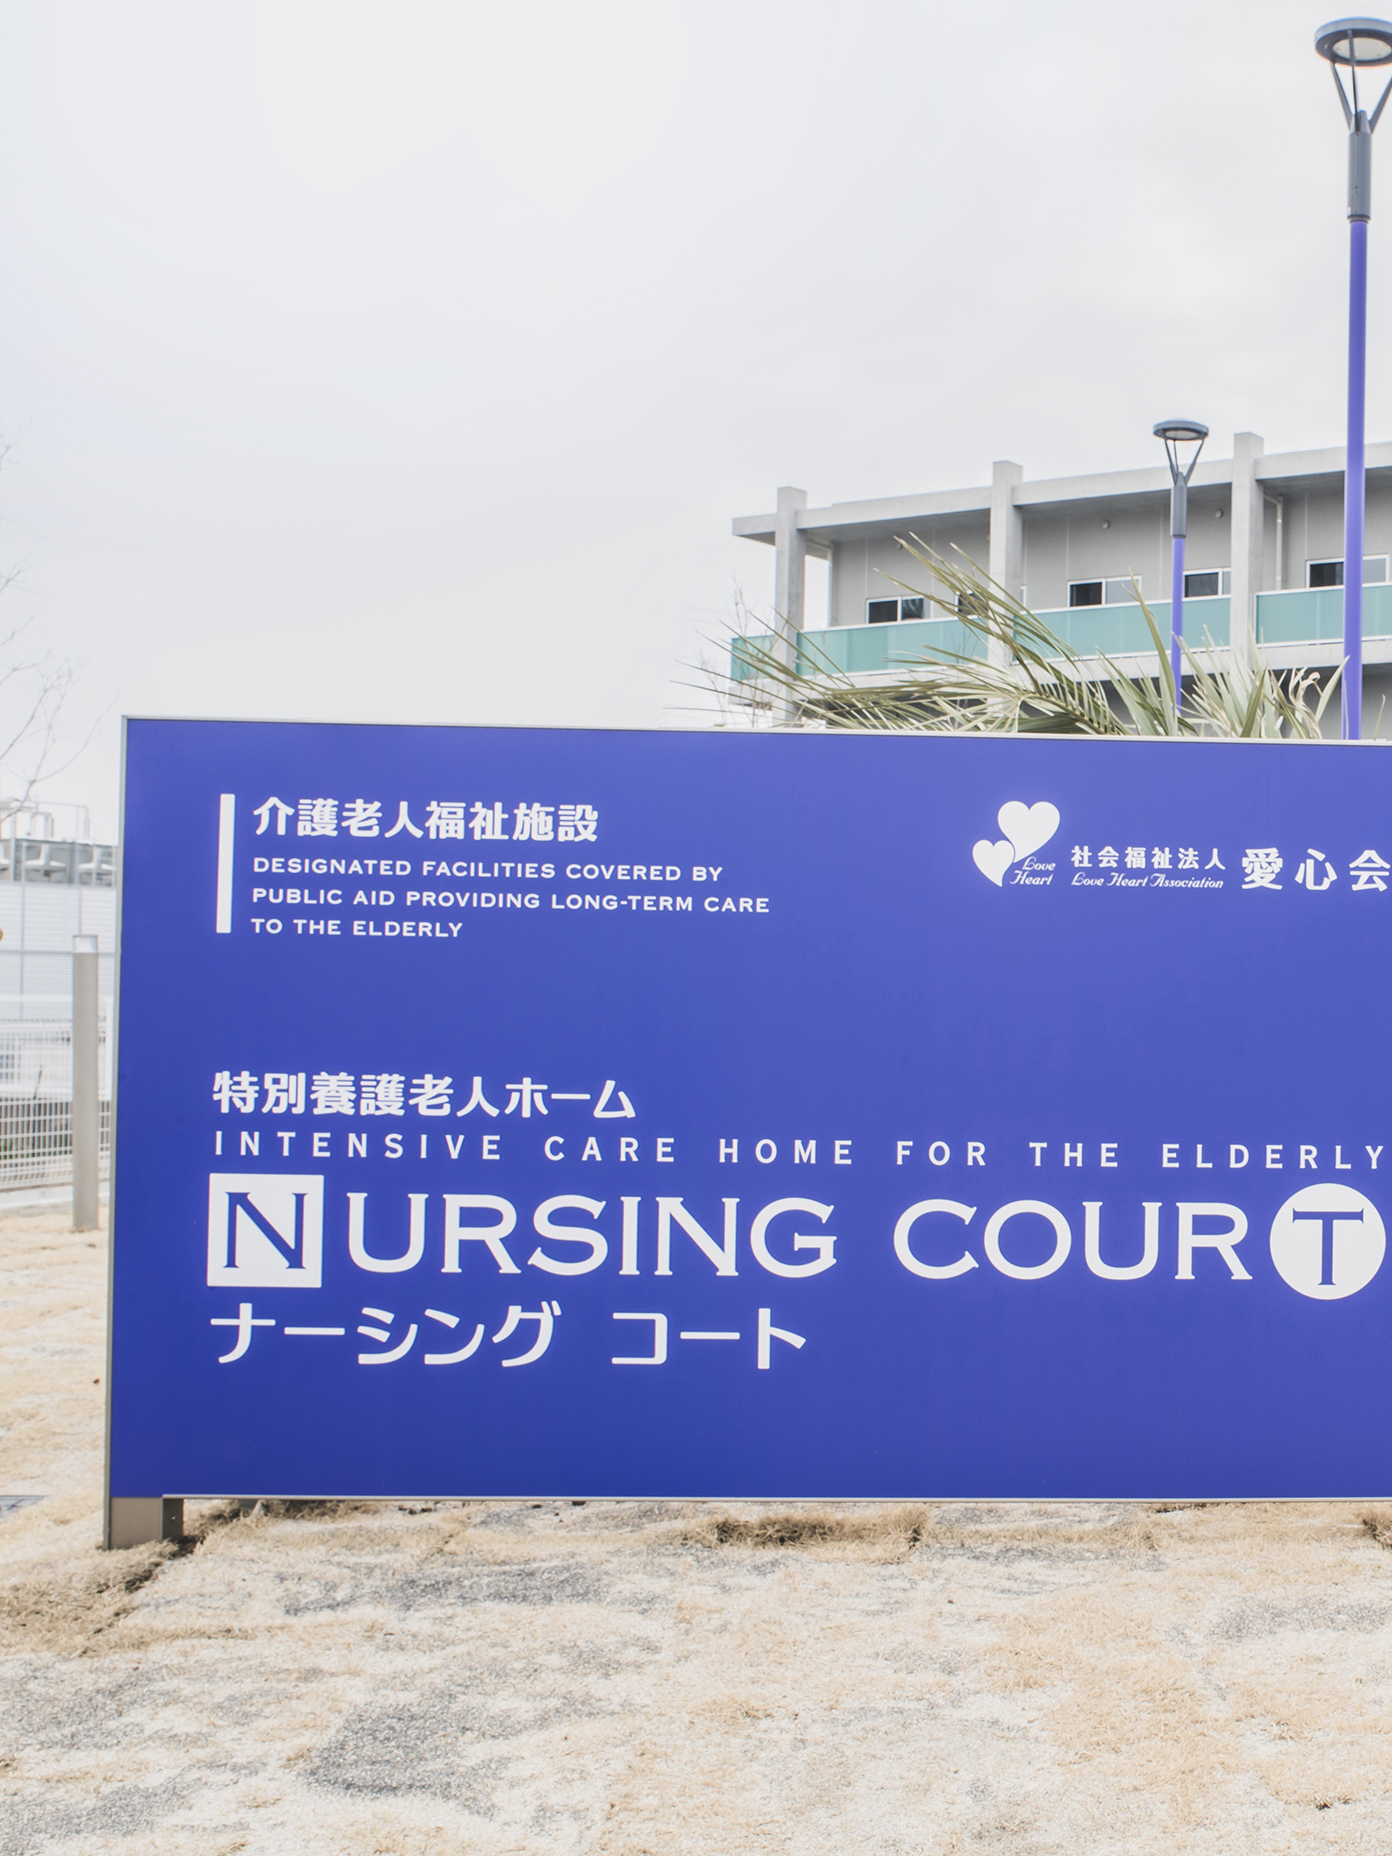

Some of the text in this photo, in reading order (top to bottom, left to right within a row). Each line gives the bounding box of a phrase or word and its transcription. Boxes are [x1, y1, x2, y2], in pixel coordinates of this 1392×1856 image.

[252, 797, 599, 843] 介護老人福祉施設
[253, 857, 723, 882] DESIGNATED FACILITIES COVERED BY
[1021, 855, 1057, 872] Love
[1070, 844, 1226, 871] 社会福祉法人
[1241, 847, 1392, 892] 愛心会
[1009, 869, 1054, 886] Heart
[1070, 871, 1224, 889] Love Heart Association
[252, 887, 770, 913] PUBLIC AID PROVIDING LONG-TERM CARE
[250, 918, 463, 938] TO THE ELDERLY
[212, 1070, 636, 1120] 特別養護老人ホーム
[215, 1130, 1384, 1170] INTENSIVE CARE HOME FOR THE ELDERLY
[208, 1174, 1387, 1300] NURSING COURT
[210, 1300, 807, 1370] ナーシング コート
